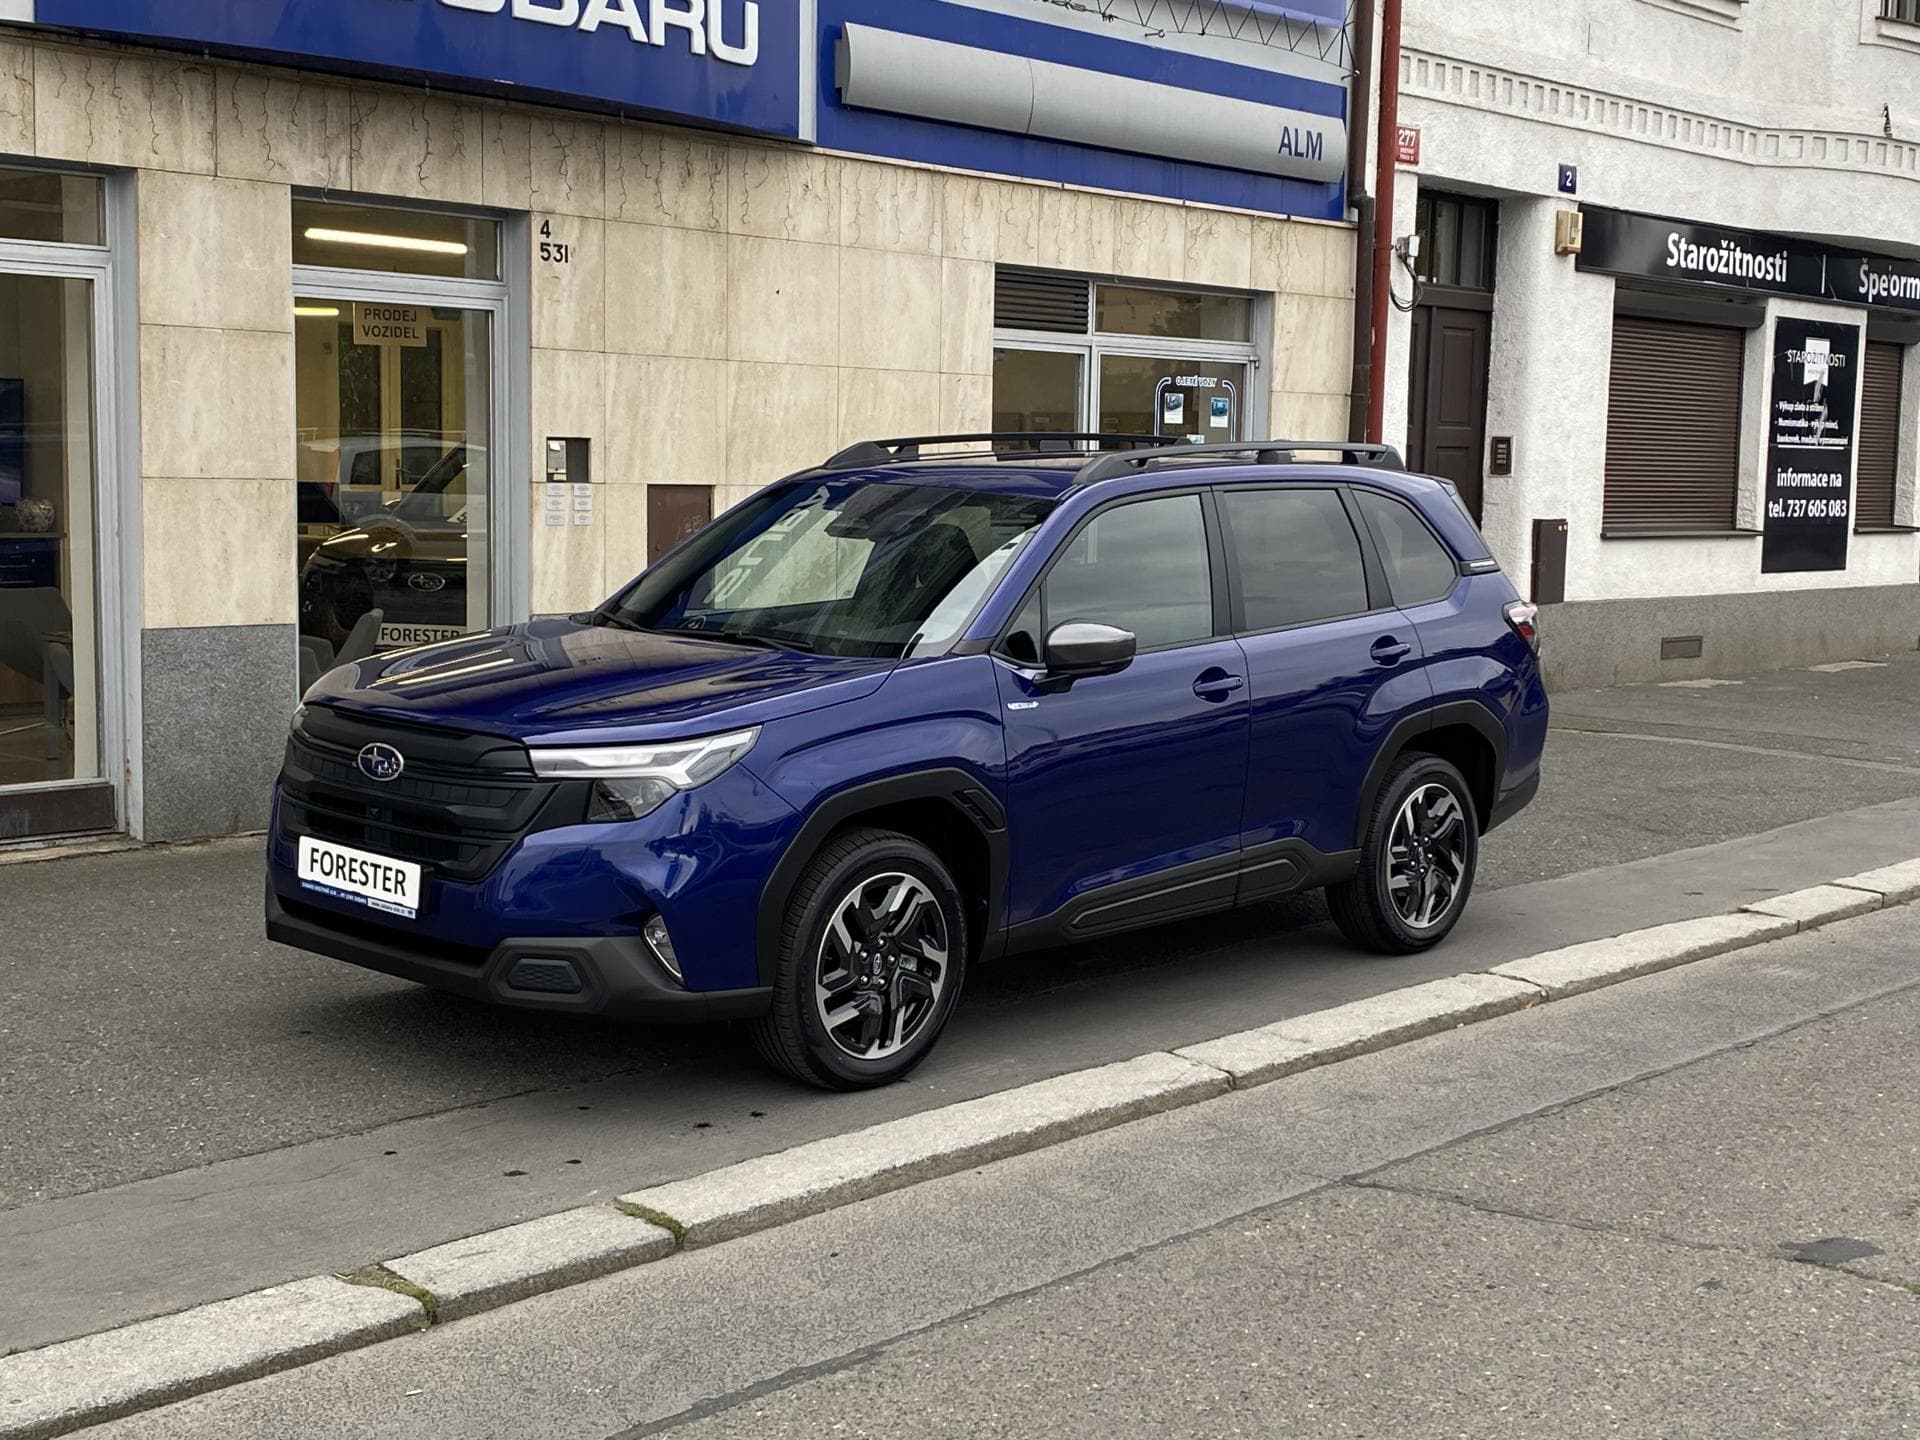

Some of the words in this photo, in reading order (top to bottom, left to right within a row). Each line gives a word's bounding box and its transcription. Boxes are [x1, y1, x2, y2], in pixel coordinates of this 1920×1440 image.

[1278, 125, 1323, 161] ALM
[1398, 129, 1416, 147] 277
[1565, 170, 1573, 187] 2
[540, 219, 551, 239] 4
[540, 242, 568, 263] 531
[1666, 232, 1787, 282] Starožitnosti
[364, 308, 417, 322] PRODEJ
[362, 324, 420, 339] VOZIDEL
[1777, 467, 1828, 487] informace
[1829, 473, 1842, 487] na
[1768, 498, 1786, 517] tel.
[1787, 499, 1807, 517] 737
[1808, 499, 1827, 517] 605
[1828, 499, 1847, 517] 083
[310, 847, 406, 897] FORESTER
